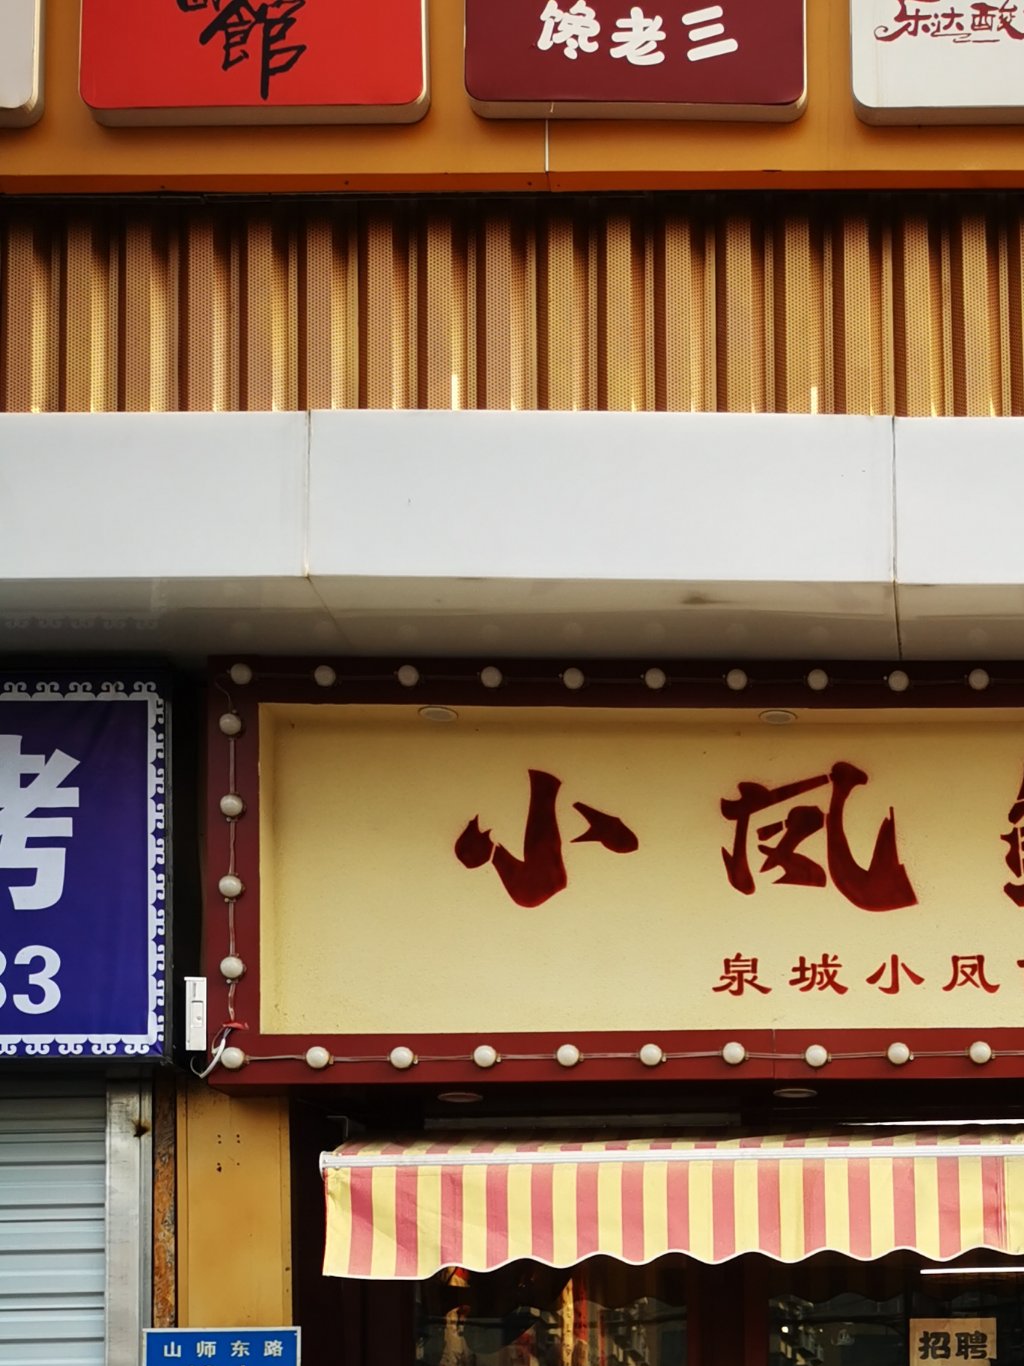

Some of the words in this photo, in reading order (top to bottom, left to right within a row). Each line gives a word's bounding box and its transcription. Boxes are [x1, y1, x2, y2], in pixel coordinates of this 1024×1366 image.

[537, 0, 738, 66] 馋老三
[0, 945, 61, 1015] 3
[164, 1340, 283, 1358] 山师东路
[918, 1331, 988, 1360] 招聘
